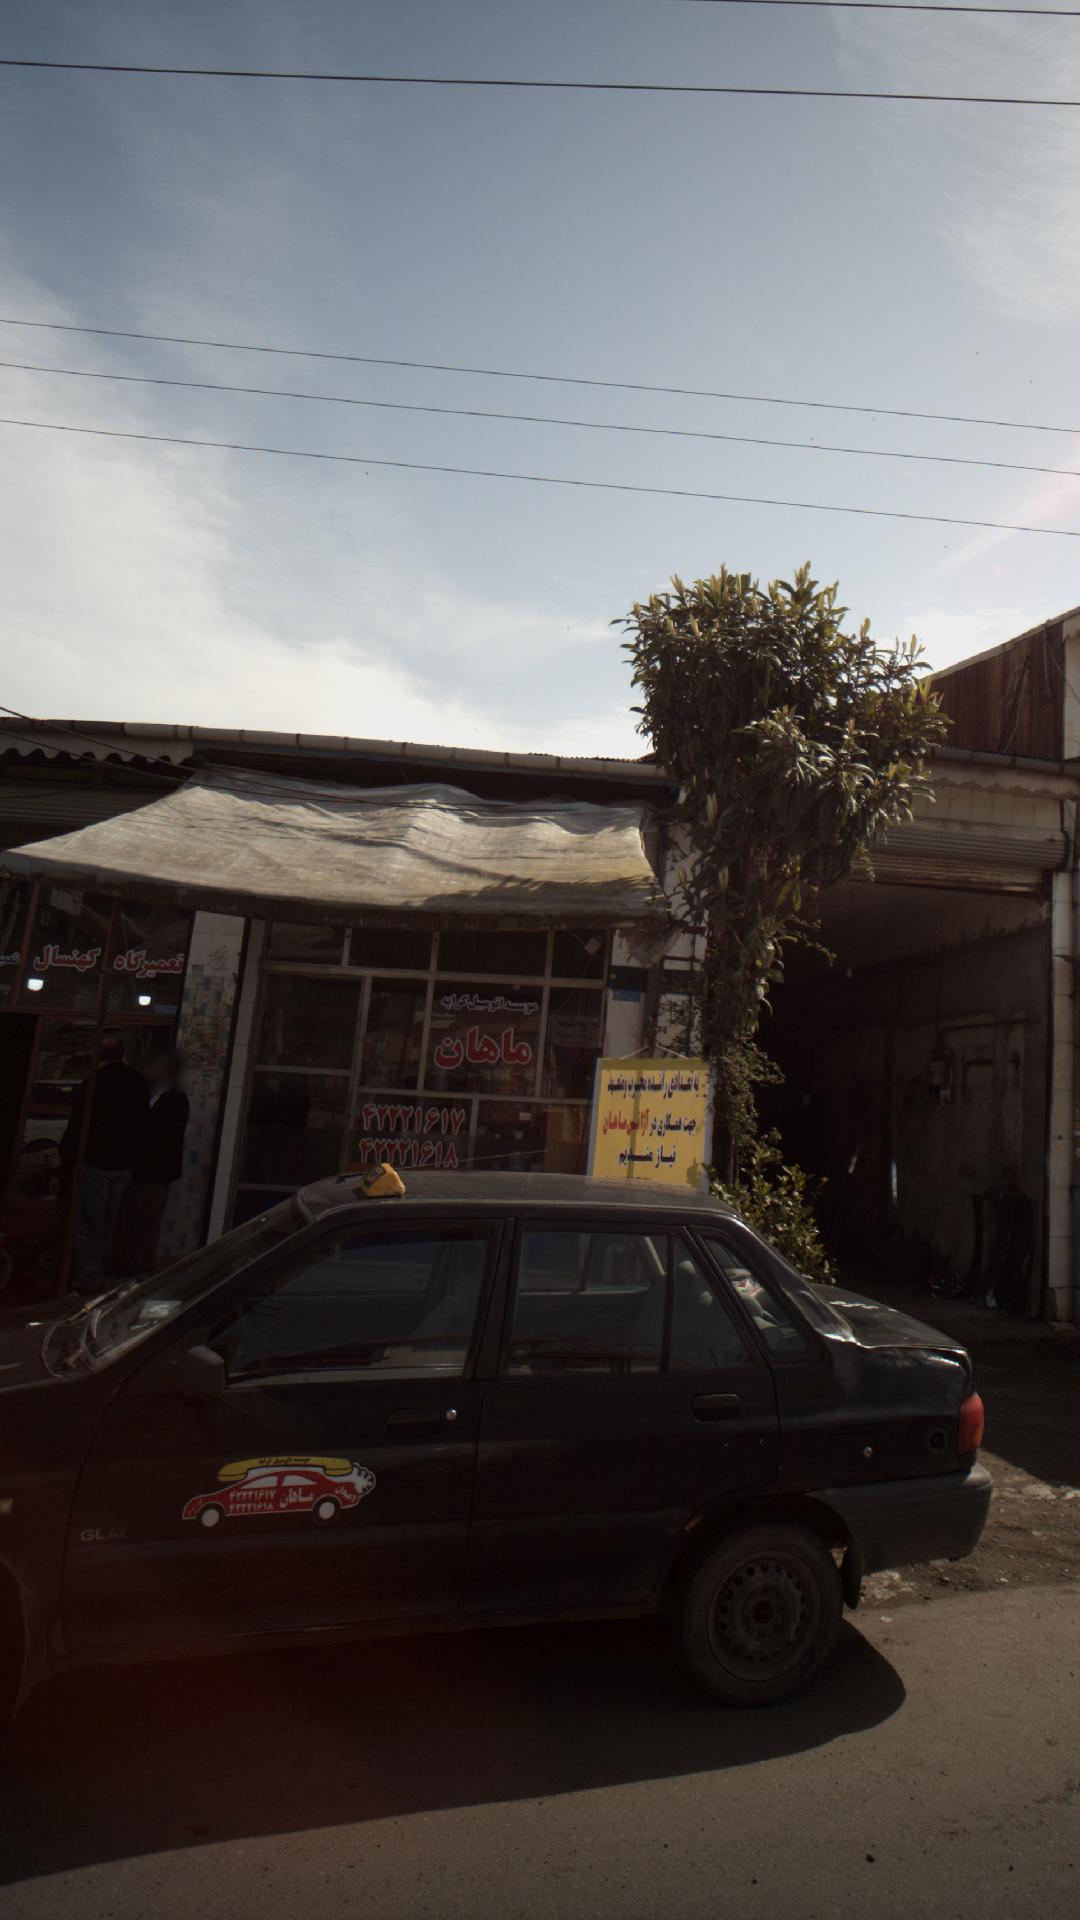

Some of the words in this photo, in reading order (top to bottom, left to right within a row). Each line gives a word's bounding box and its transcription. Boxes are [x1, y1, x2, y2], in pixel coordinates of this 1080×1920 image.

[33, 944, 101, 972] کهنسال
[113, 949, 185, 978] تعمیرگاه
[434, 1026, 532, 1070] ماهان
[279, 1486, 314, 1509] ماهان
